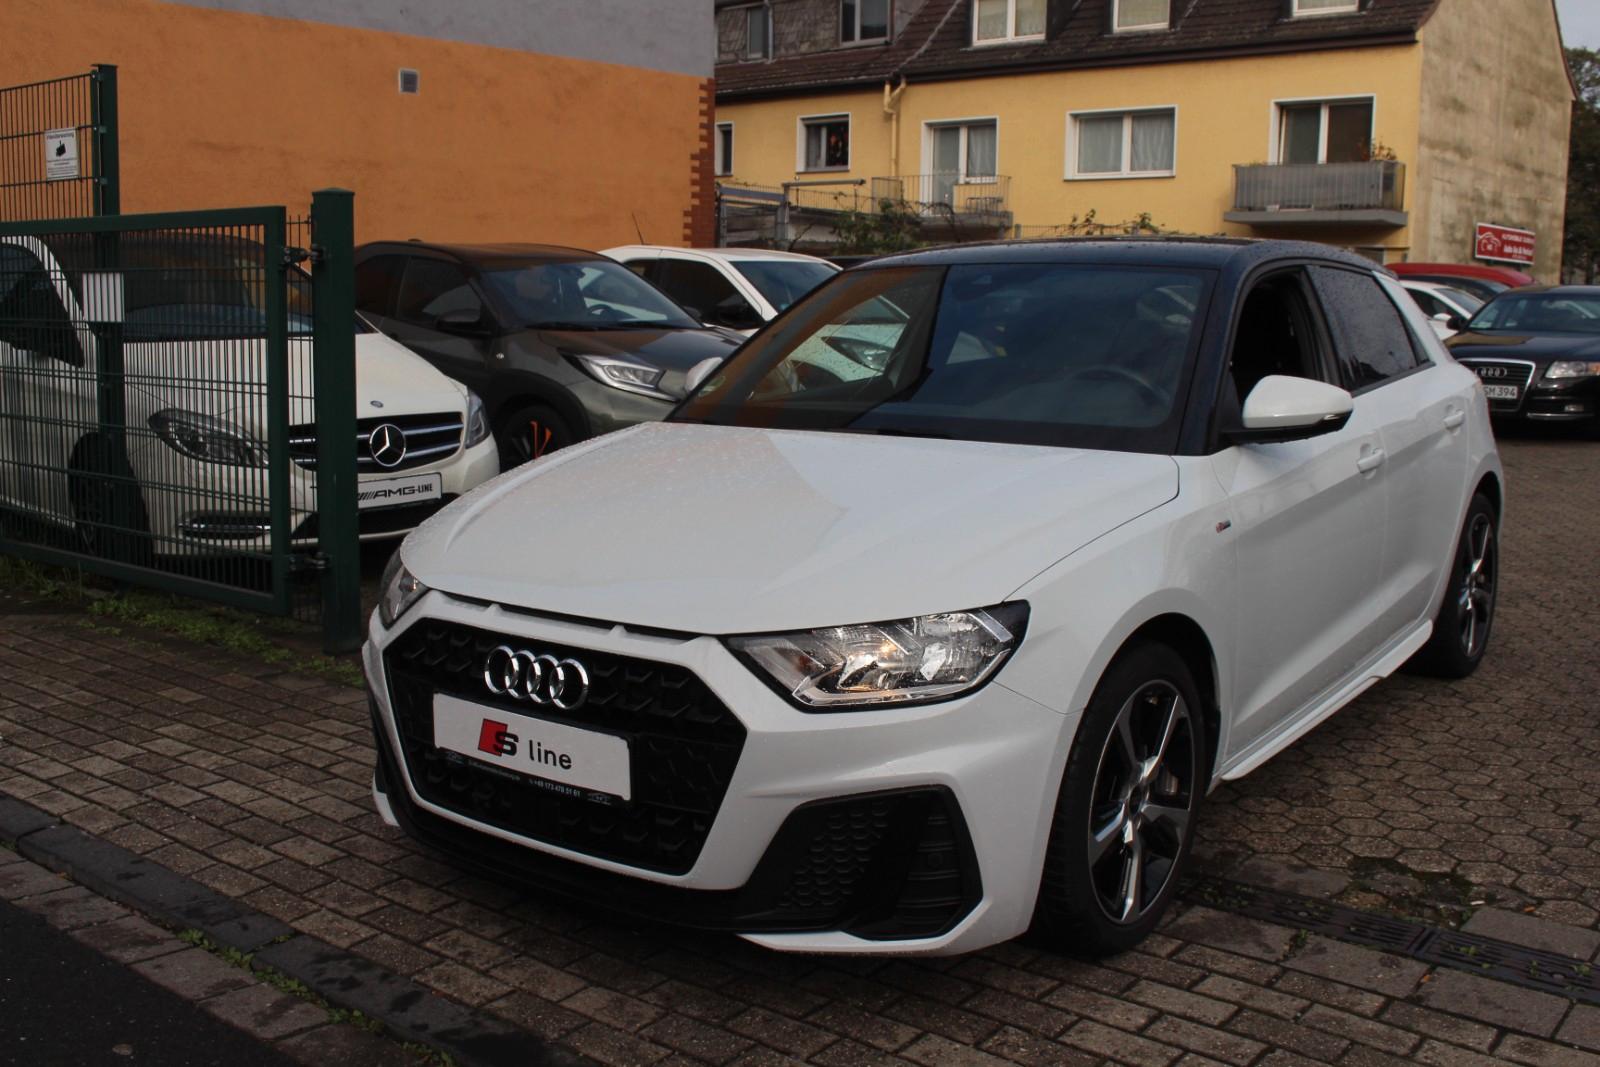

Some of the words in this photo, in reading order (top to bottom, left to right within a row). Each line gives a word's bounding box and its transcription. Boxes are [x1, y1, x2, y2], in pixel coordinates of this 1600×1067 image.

[1496, 386, 1515, 397] 394
[492, 731, 519, 757] S
[528, 739, 572, 770] line
